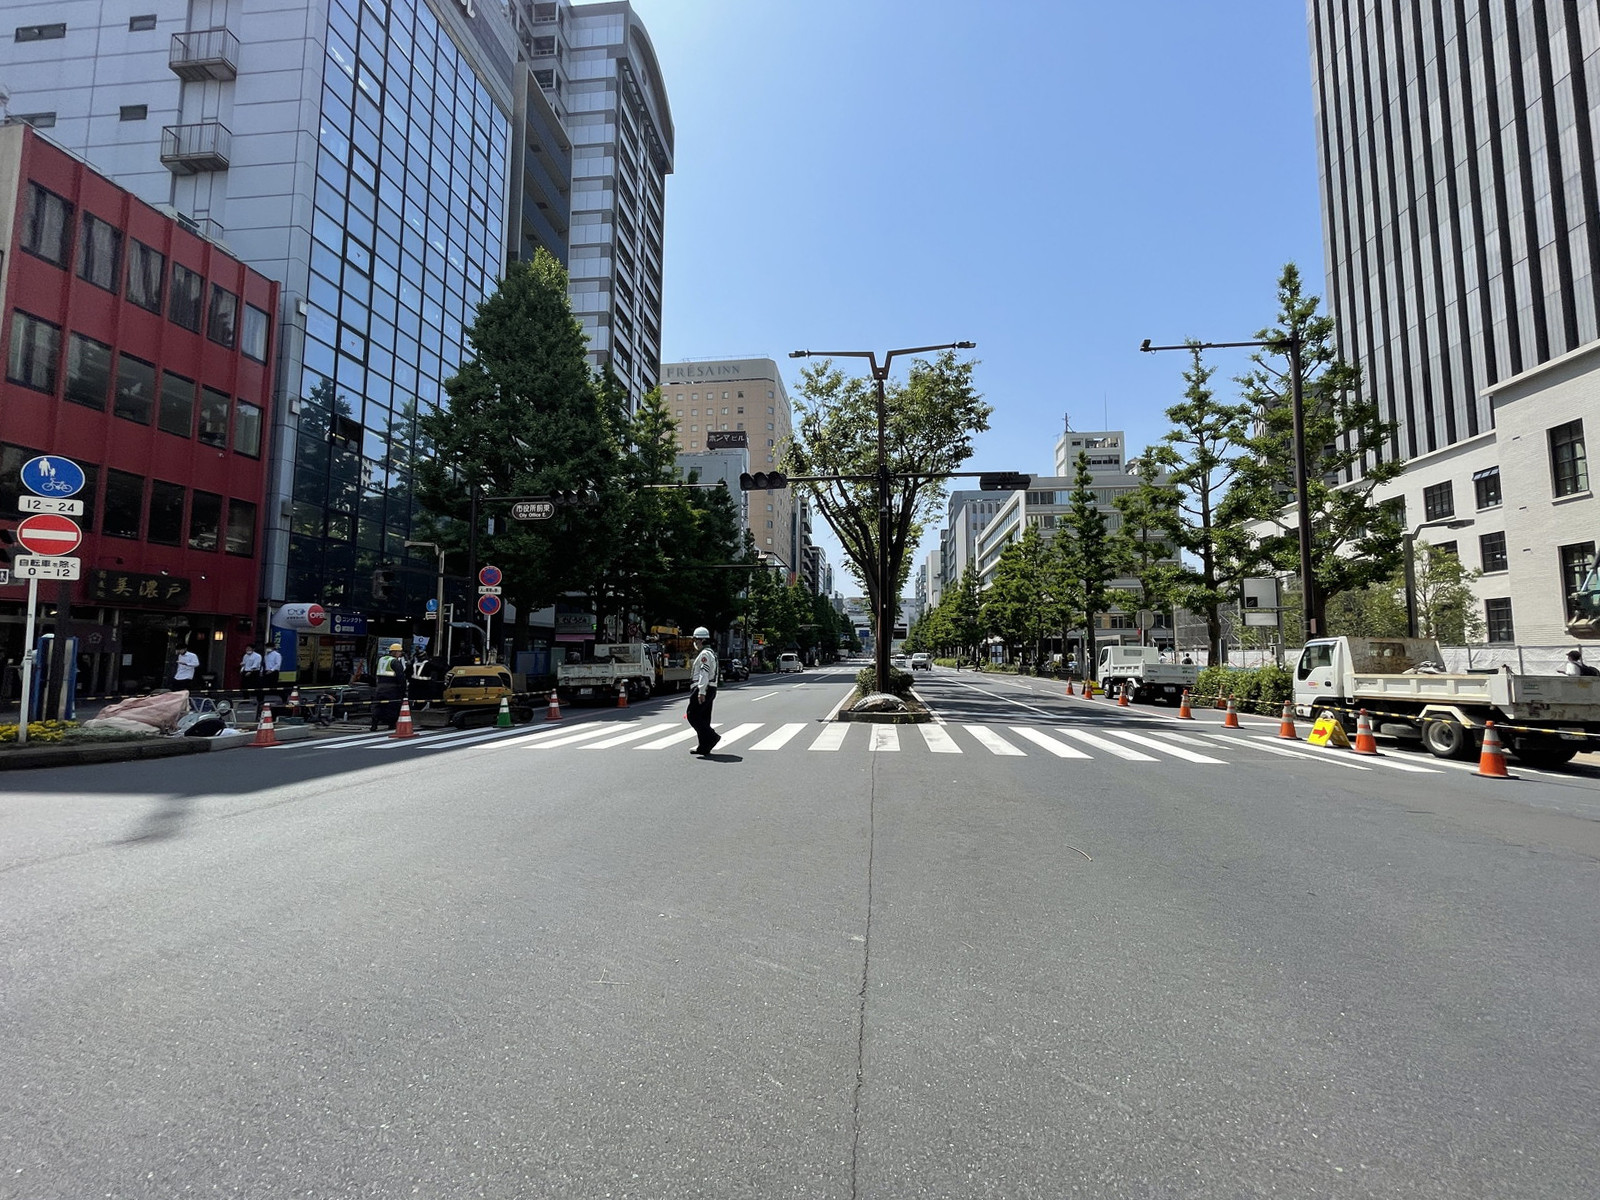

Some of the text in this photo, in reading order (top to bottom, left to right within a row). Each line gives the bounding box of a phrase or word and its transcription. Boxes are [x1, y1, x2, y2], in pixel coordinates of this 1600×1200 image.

[718, 366, 740, 375] INN
[708, 434, 745, 443] ホンマビル
[112, 577, 181, 599] 美濃戸
[342, 616, 362, 624] コンタクト
